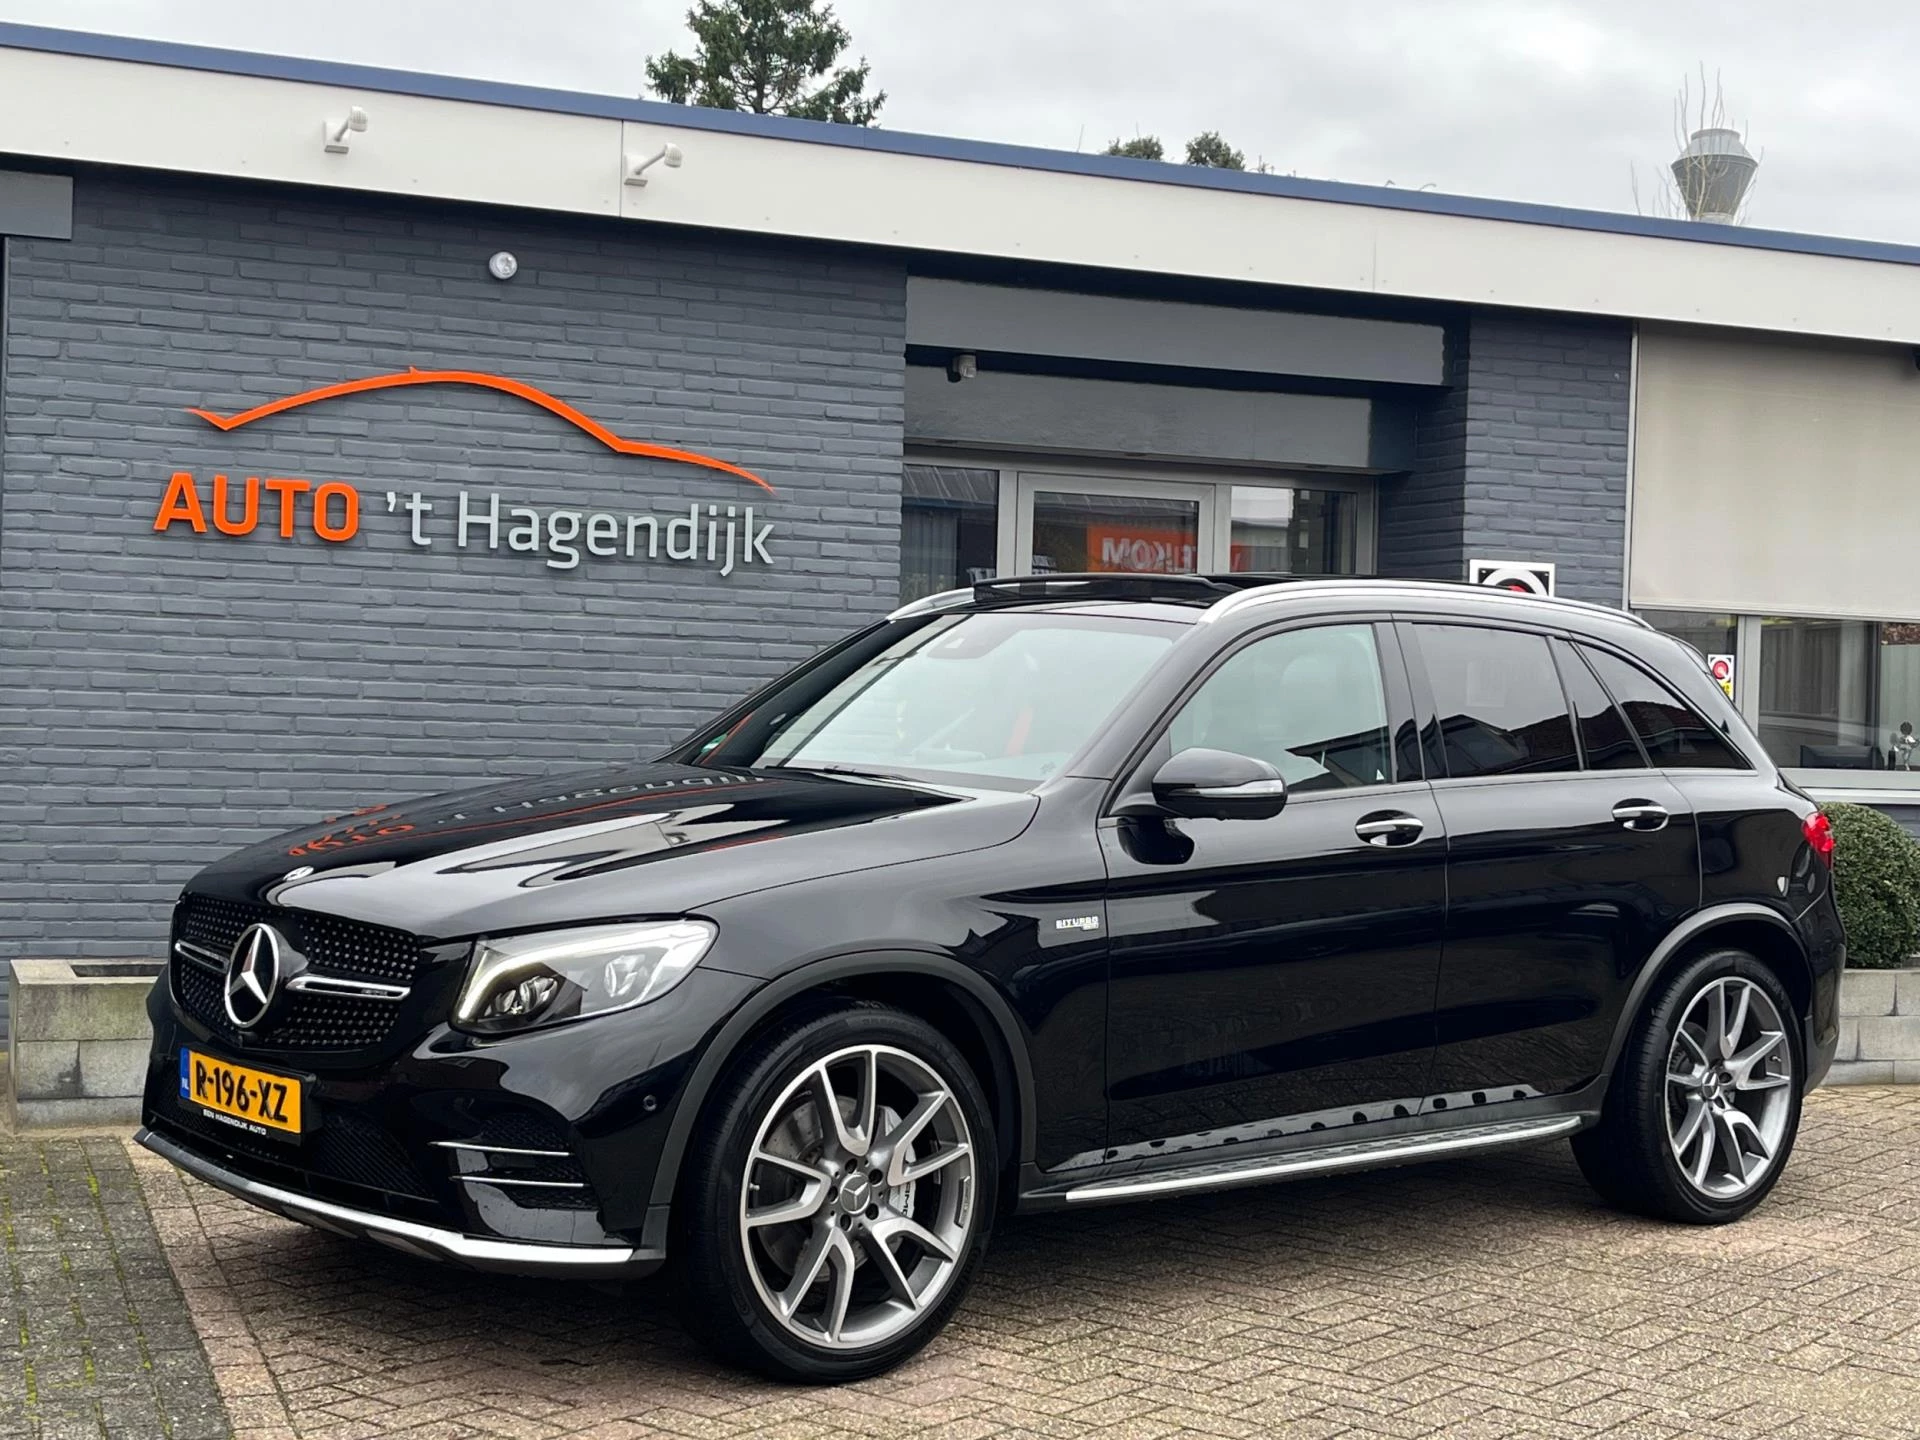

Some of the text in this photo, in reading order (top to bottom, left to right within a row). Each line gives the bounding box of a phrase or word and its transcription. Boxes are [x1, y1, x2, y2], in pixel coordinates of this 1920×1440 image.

[153, 473, 775, 576] AUTO 't Hagendijk
[181, 1077, 189, 1090] NL
[195, 1060, 288, 1123] R-196-XZ
